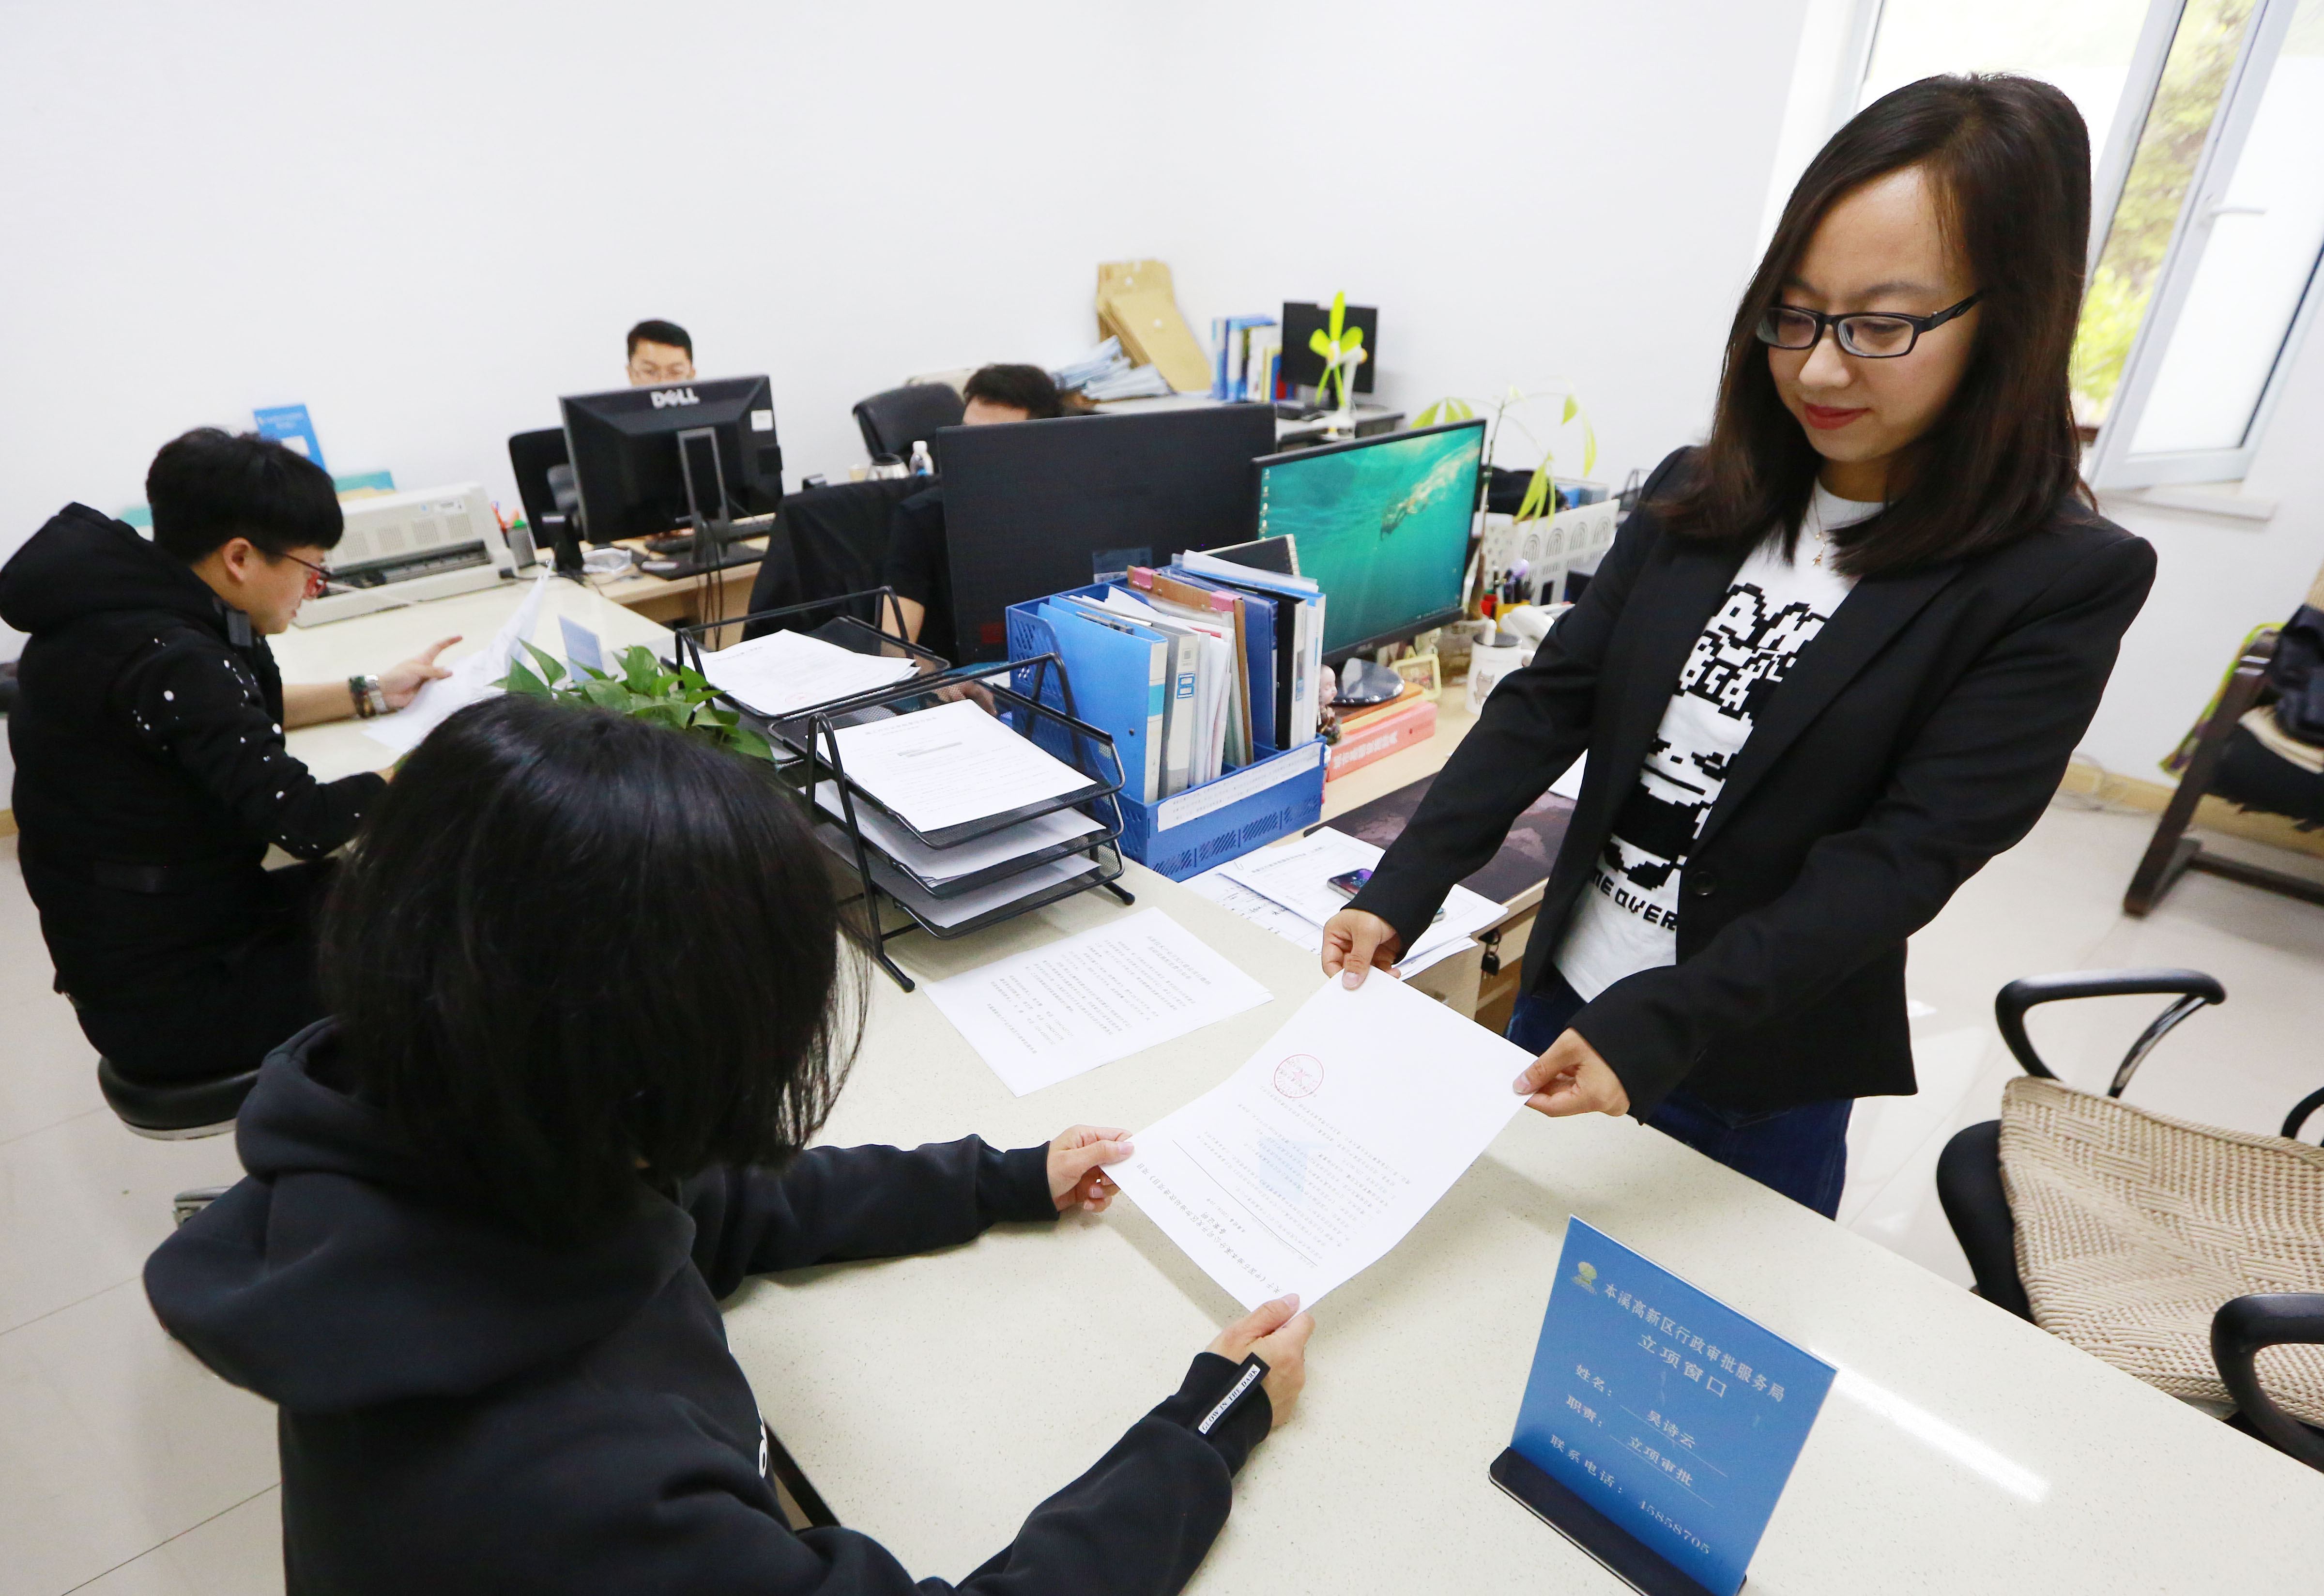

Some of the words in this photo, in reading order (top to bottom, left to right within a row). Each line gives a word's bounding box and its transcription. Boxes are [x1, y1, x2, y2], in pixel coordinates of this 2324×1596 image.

[651, 388, 700, 409] DELL
[1615, 888, 1678, 931] OVER
[1604, 1284, 1785, 1402] 本溪高新区行政审批服务局
[1637, 1334, 1728, 1398] 立项窗口
[1202, 1410, 1220, 1431] GLOW
[1220, 1401, 1227, 1411] IN
[1228, 1388, 1241, 1401] THE
[1241, 1368, 1258, 1388] DARK
[1648, 1410, 1696, 1449] 吴诗云
[1627, 1436, 1693, 1487] 立项审批
[1638, 1500, 1710, 1554] 45858705
